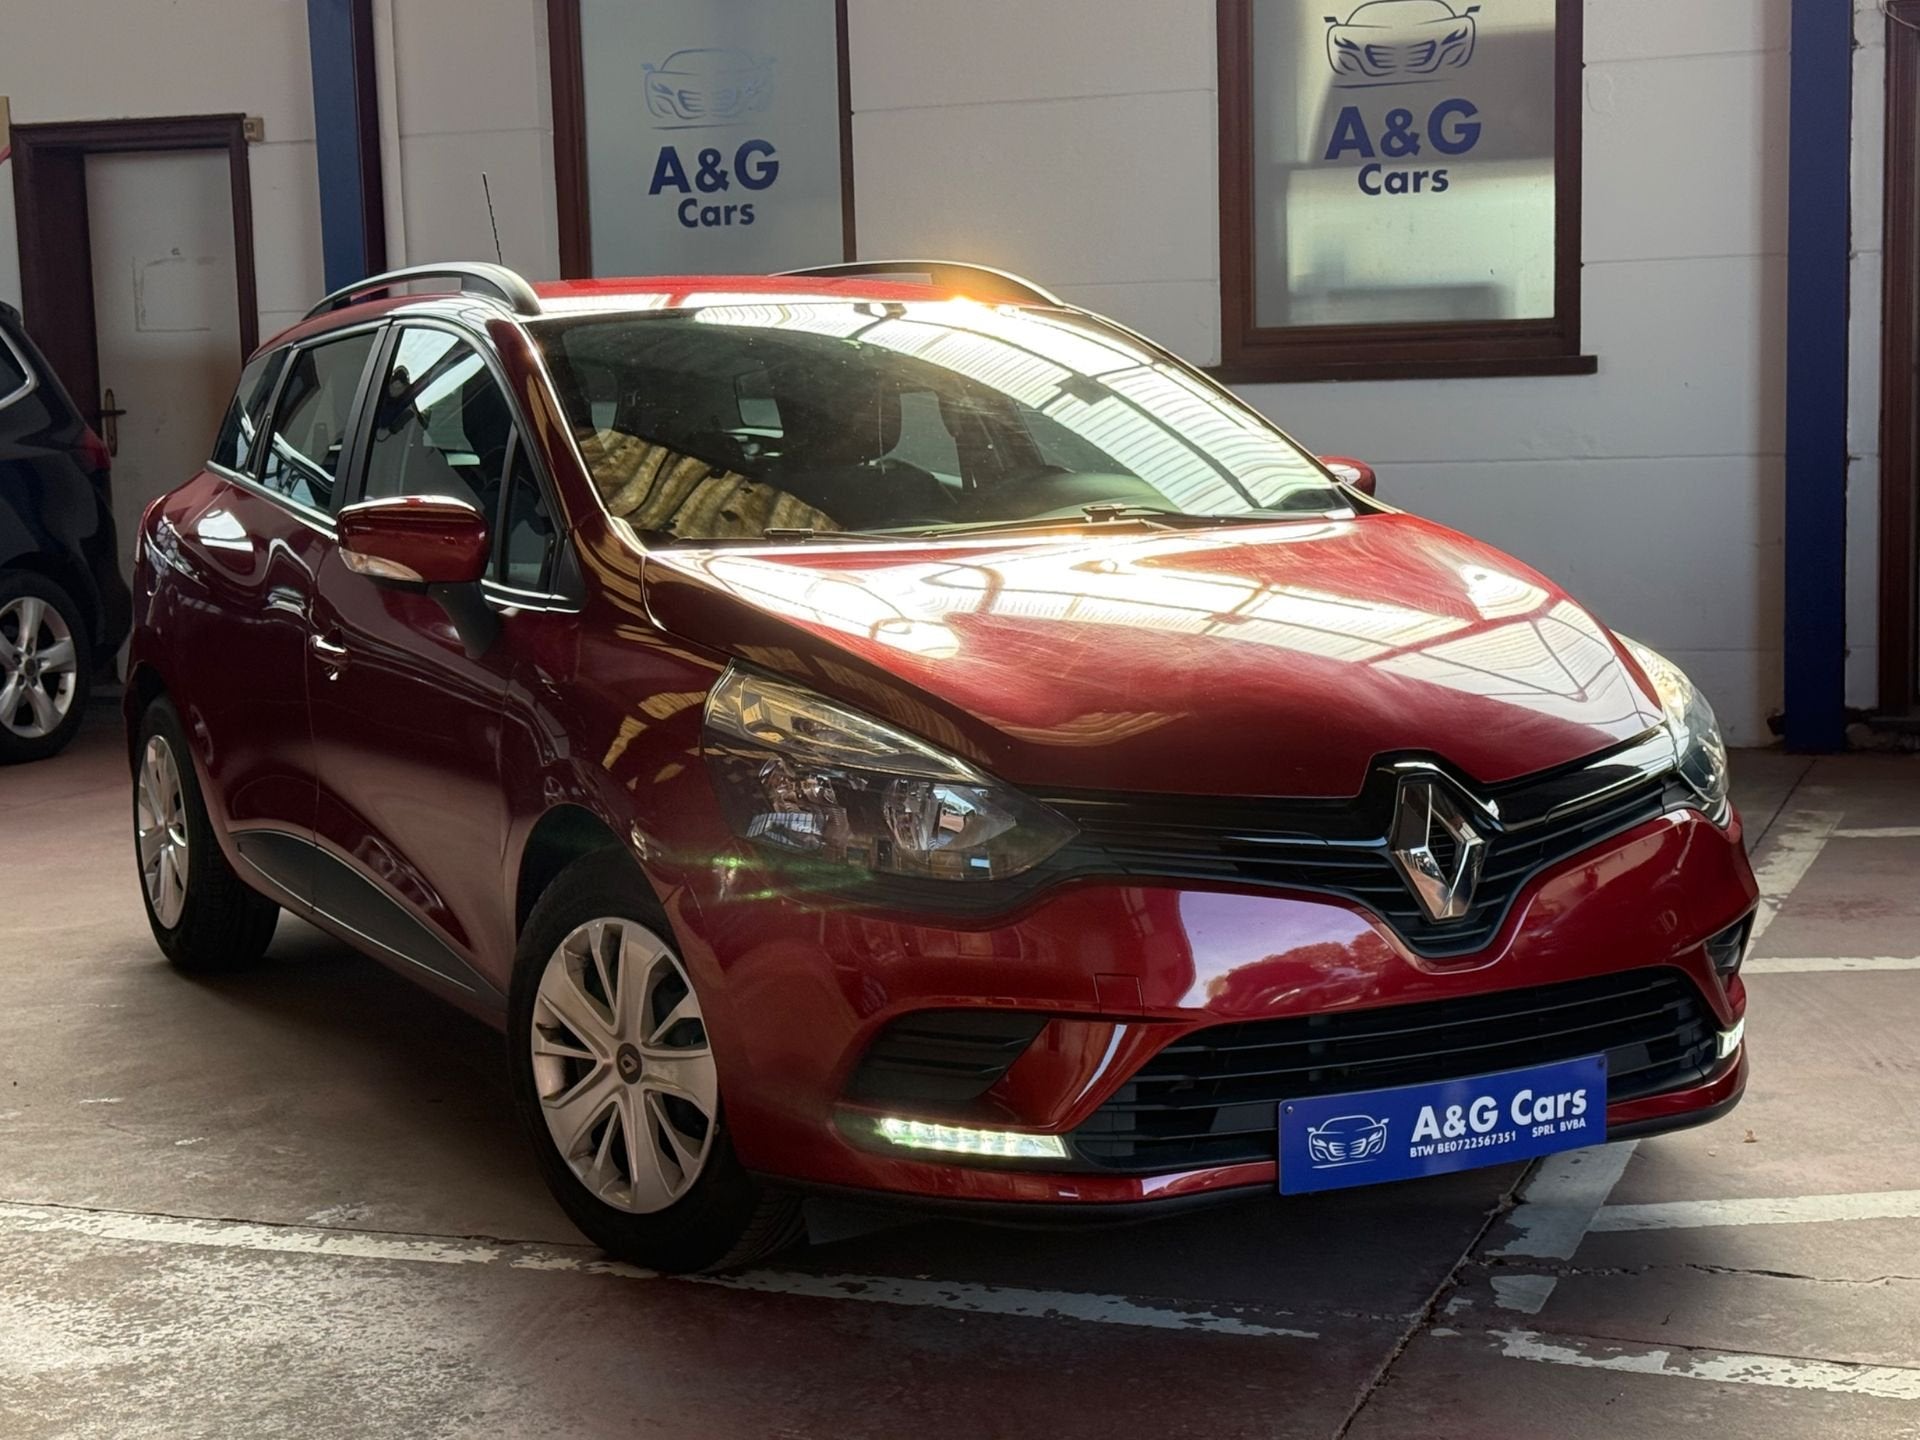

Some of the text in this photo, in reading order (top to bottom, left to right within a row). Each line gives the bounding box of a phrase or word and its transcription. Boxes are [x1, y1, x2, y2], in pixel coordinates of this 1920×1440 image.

[1324, 98, 1482, 160] A&G
[648, 139, 779, 195] A&G
[1358, 163, 1449, 196] Cars
[678, 198, 755, 228] Cars
[1409, 1118, 1586, 1158] BTW BE0722567351 SPRL BVBA
[1410, 1088, 1587, 1143] A&G Cars
